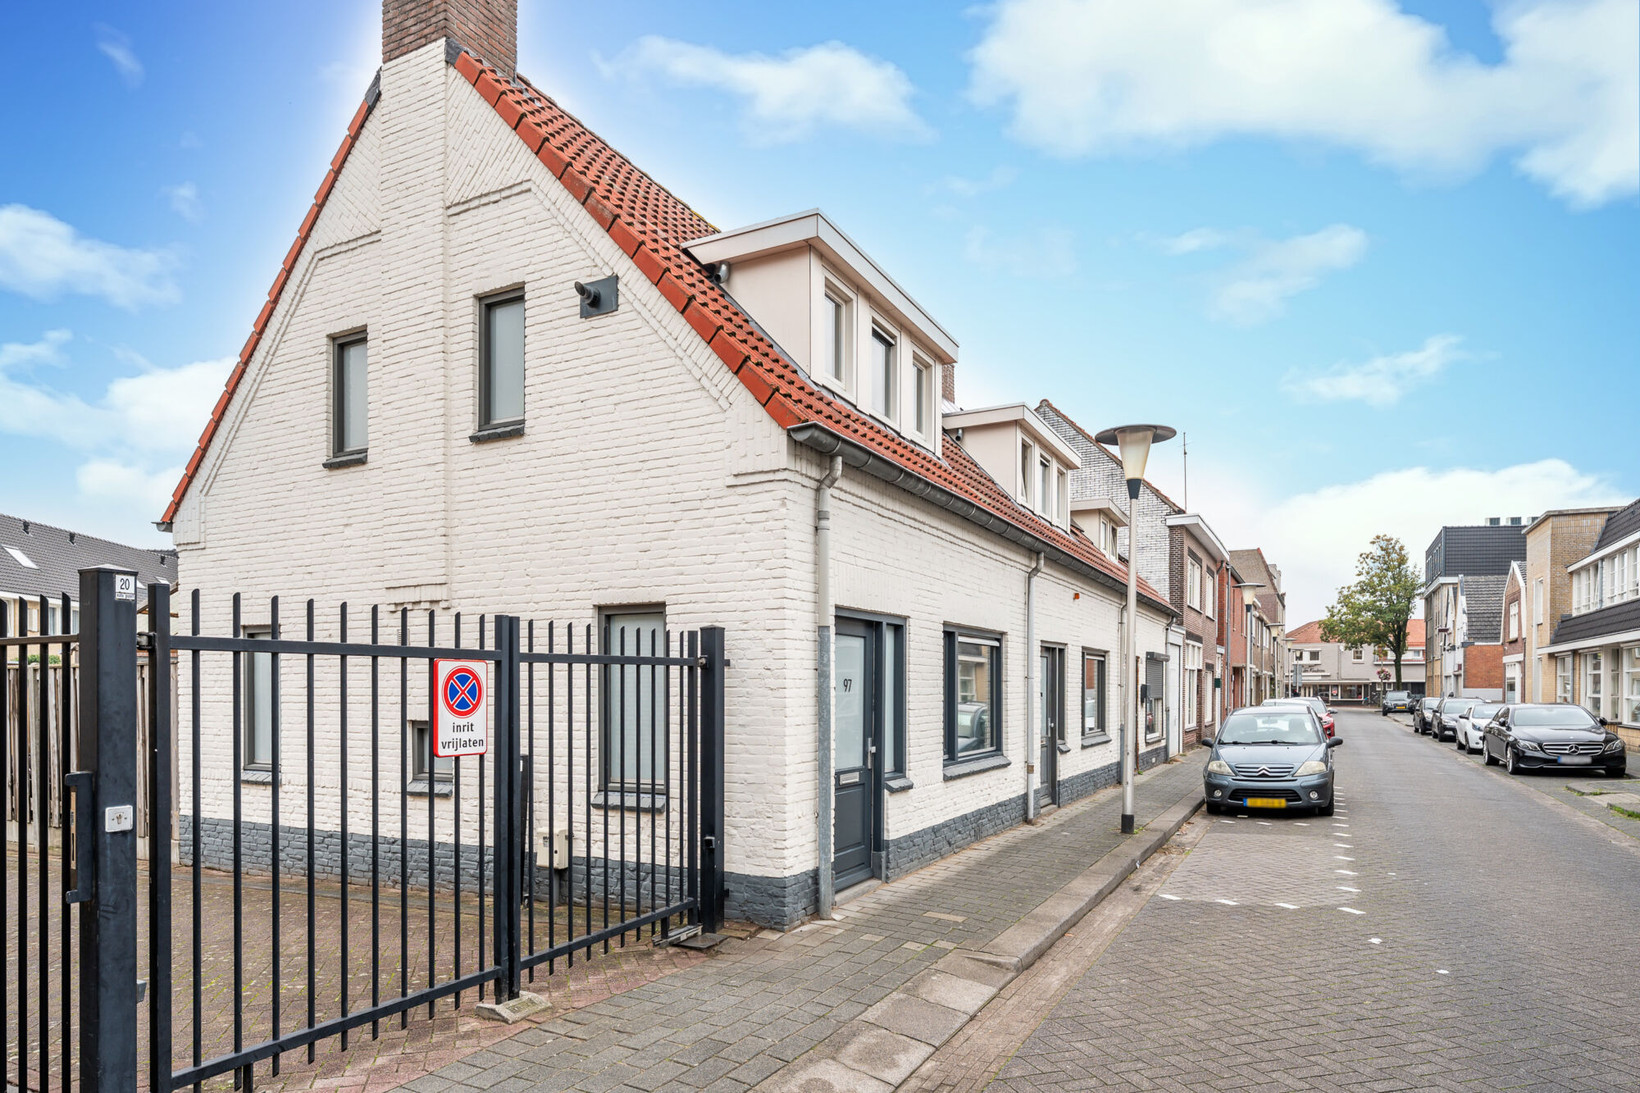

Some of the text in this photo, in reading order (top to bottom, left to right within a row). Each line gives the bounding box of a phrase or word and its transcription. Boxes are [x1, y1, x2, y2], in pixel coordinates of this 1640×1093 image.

[120, 578, 131, 591] 20
[843, 678, 852, 692] 97
[452, 721, 474, 732] inrit
[441, 737, 484, 751] vrijlaten
